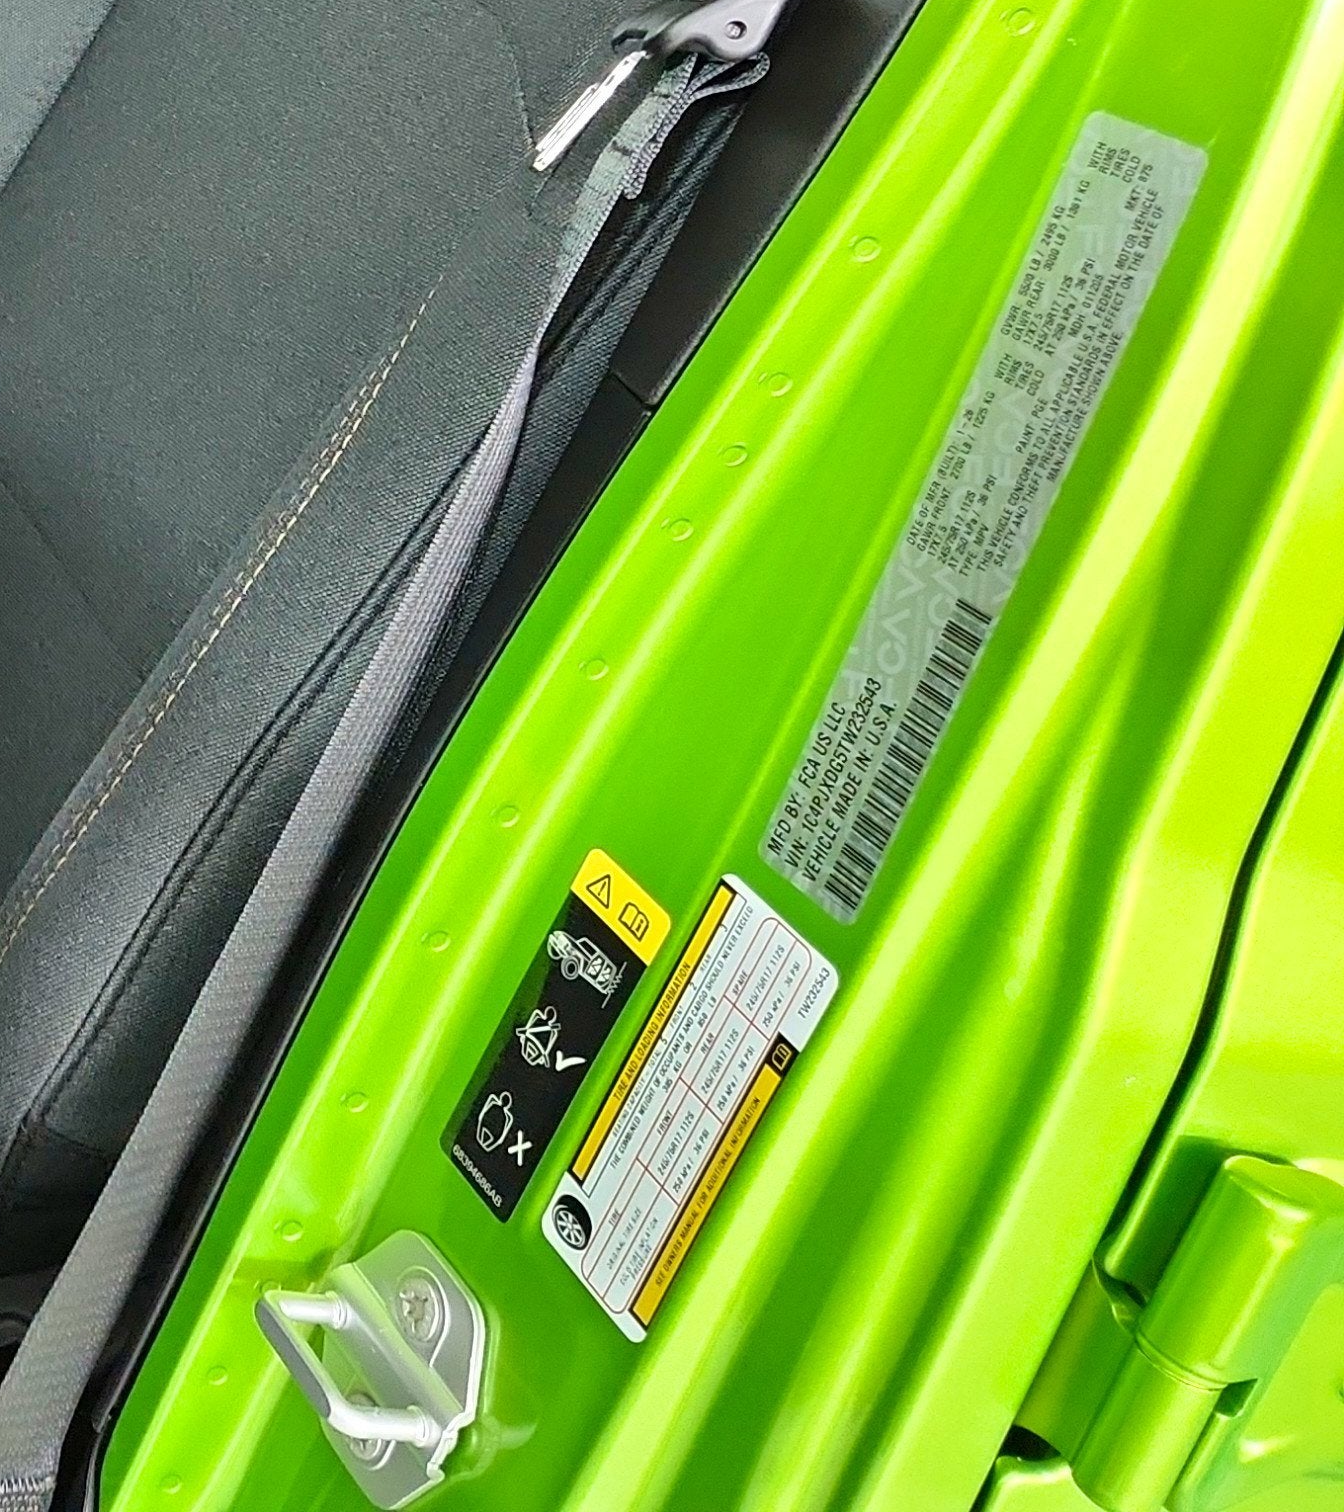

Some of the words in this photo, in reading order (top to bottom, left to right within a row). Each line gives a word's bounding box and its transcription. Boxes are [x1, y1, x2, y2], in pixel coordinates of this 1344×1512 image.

[1086, 140, 1108, 170] WITH
[1097, 146, 1118, 174] RIMS
[1108, 146, 1131, 179] TIRES
[1120, 154, 1142, 183] COLD
[1130, 187, 1159, 232] VEHICLE
[1149, 203, 1165, 220] OF
[1136, 219, 1159, 249] DATE
[1113, 232, 1138, 270] MOTOR
[1126, 249, 1145, 273] THE
[1091, 271, 1121, 319] FEDERAL
[1118, 273, 1134, 291] ON
[1043, 341, 1057, 357] AT
[1080, 256, 1096, 275] PSI
[1100, 291, 1127, 330] EFFECT
[1010, 308, 1032, 341] GAWR
[1094, 329, 1108, 344] IN
[992, 351, 1013, 380] WITH
[1003, 357, 1023, 385] RIMS
[1013, 360, 1035, 391] TIRES
[1065, 344, 1103, 407] STANDARDS
[1025, 368, 1046, 397] COLD
[1048, 352, 1084, 414] APPLICABLE
[1036, 406, 1074, 470] PREVENTION
[1038, 414, 1056, 435] ALL
[1044, 407, 1087, 483] MANUFACTURE
[1079, 366, 1106, 407] SHOWN
[1031, 434, 1046, 451] TO
[1006, 450, 1040, 506] CONFORMS
[1020, 470, 1044, 505] THEFT
[905, 518, 924, 546] DATE
[917, 503, 931, 518] OF
[924, 479, 942, 503] MFR
[946, 554, 961, 570] AT
[981, 473, 998, 492] PSI
[987, 507, 1013, 549] VEHICLE
[1010, 503, 1029, 528] AND
[915, 520, 937, 552] GAWR
[972, 522, 990, 547] MPV
[992, 527, 1018, 567] SAFETY
[975, 547, 994, 573] THIS
[821, 699, 847, 733] LLC
[811, 729, 833, 757] US
[796, 755, 822, 789] FCA
[782, 788, 806, 820] BY:
[801, 817, 841, 884] VEHICLE
[830, 771, 862, 820] MADE
[852, 745, 874, 773] IN:
[863, 695, 898, 748] U.S.A.
[766, 816, 793, 856] MFD
[783, 833, 809, 870] VIN:
[731, 968, 749, 996] SPARE
[797, 965, 831, 1020] TW232543
[612, 1078, 628, 1103] TIRE
[623, 1058, 639, 1081] AND
[633, 1020, 659, 1062] LOADING
[654, 959, 691, 1024] INFORMATION
[699, 1031, 714, 1054] REAR
[609, 1152, 621, 1170] THE
[617, 1114, 641, 1155] COMBINED
[637, 1086, 656, 1117] WEIGHT
[652, 1075, 662, 1088] OF
[658, 1032, 685, 1078] OCCUPANTS
[681, 1015, 695, 1034] AND
[690, 989, 709, 1018] CARGO
[704, 959, 725, 992] SHOULD
[721, 934, 738, 962] NEVER
[655, 1107, 673, 1136] FRONT
[654, 1270, 666, 1287] SEE
[678, 1208, 699, 1241] MANUAL
[696, 1190, 709, 1209] FOR
[704, 1147, 732, 1193] ADDITIONAL
[728, 1094, 761, 1149] INFORMATION
[607, 1207, 621, 1227] TIRE
